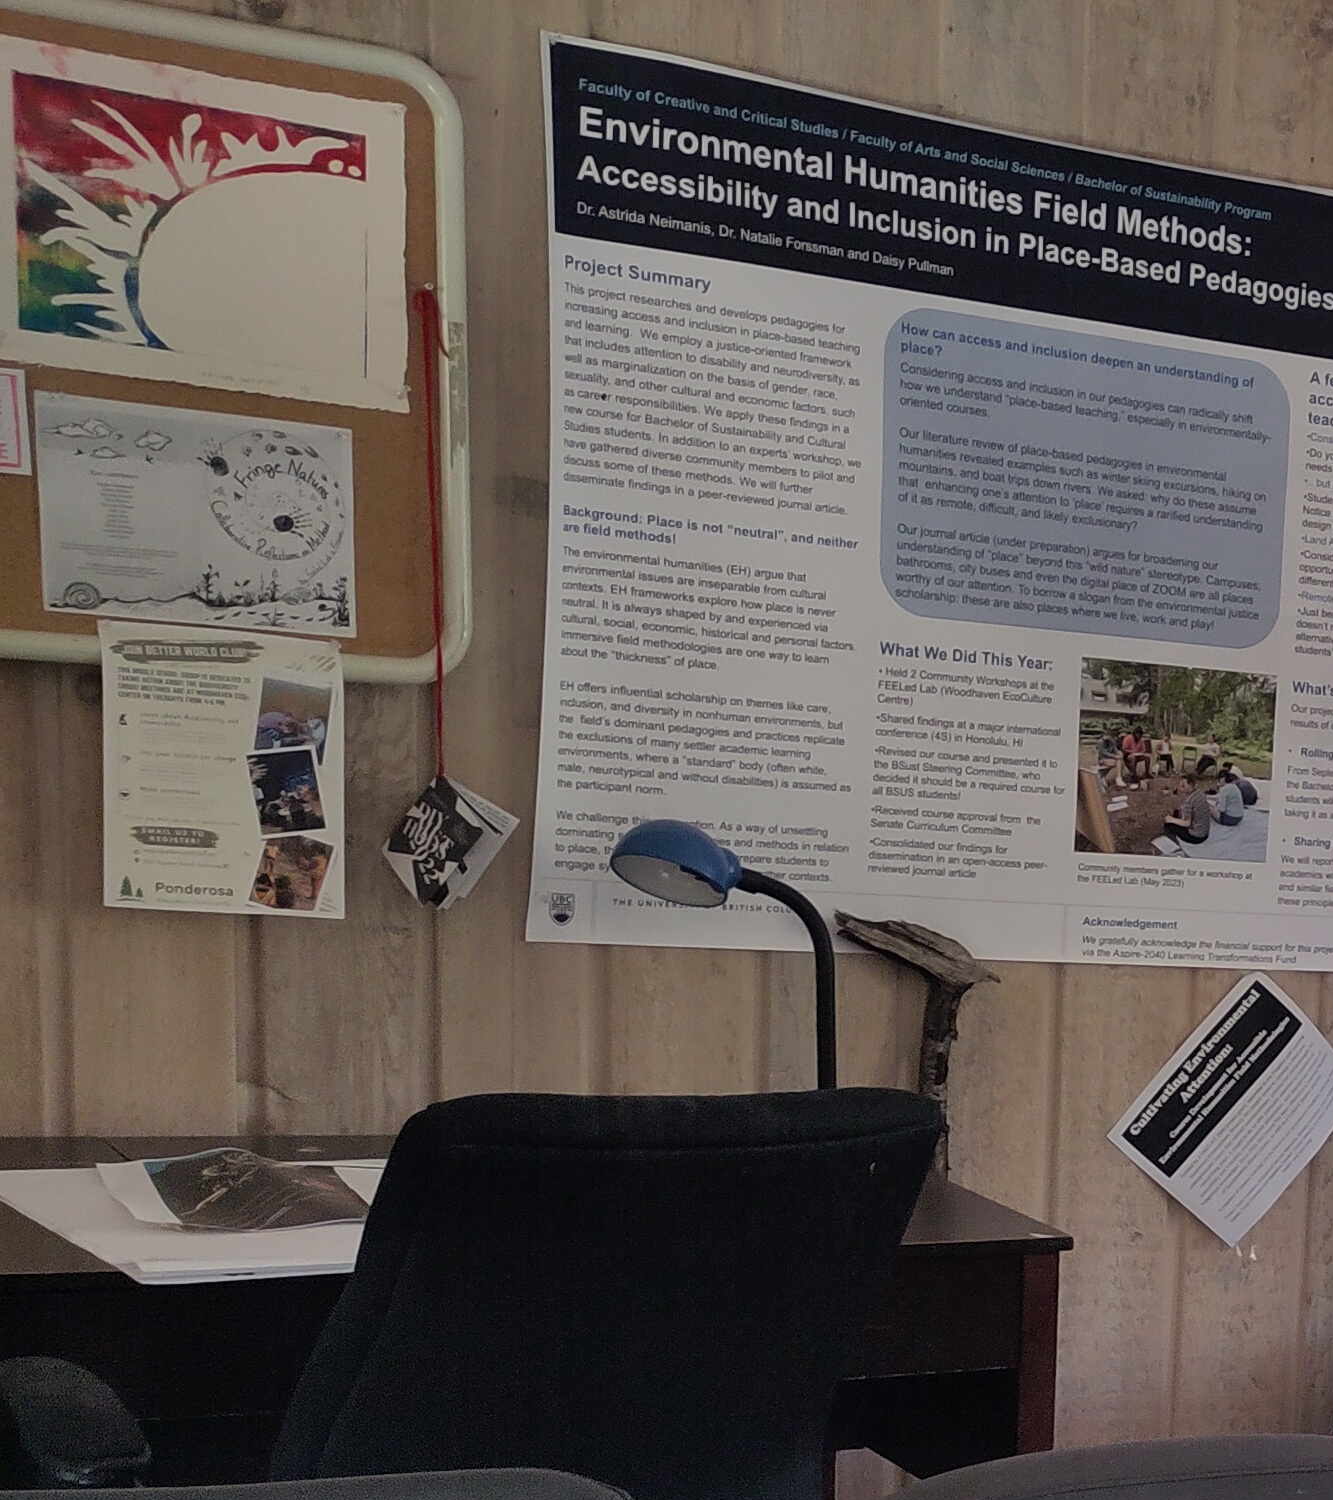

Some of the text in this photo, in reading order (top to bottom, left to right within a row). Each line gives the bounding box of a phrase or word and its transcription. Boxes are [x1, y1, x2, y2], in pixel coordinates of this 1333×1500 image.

[578, 77, 632, 101] Faculty
[635, 89, 651, 102] of
[654, 91, 710, 113] Creative
[713, 105, 737, 119] and
[740, 108, 787, 128] Critical
[790, 118, 839, 139] Studies
[850, 129, 897, 152] Faculty
[899, 140, 914, 152] of
[914, 142, 941, 158] Arts
[943, 150, 968, 163] and
[970, 153, 1008, 171] Social
[1010, 161, 1065, 182] Sciences
[1074, 173, 1128, 193] Bachelor
[1129, 184, 1143, 196] of
[1144, 186, 1222, 214] Sustainability
[1224, 201, 1272, 221] Program
[580, 105, 1251, 256] Environmental Humanities Field Methods:
[576, 155, 778, 218] Accessibility
[787, 197, 839, 224] and
[849, 201, 976, 248] Inclusion
[985, 226, 1009, 254] in
[1018, 232, 1180, 284] Place-Based
[576, 201, 954, 276] Dr. Astrida Neimanis, Dr. Natalie Forssman and Daisy Pullman
[564, 254, 711, 294] Project Summary
[900, 341, 942, 356] place?
[901, 321, 1254, 389] How can access and inclusion deepen an understanding of
[1309, 371, 1320, 385] A
[234, 458, 330, 499] Fringe Natures
[562, 522, 676, 544] are field methods!
[563, 504, 642, 524] Background:
[647, 514, 683, 529] Place
[686, 518, 698, 531] is
[702, 523, 723, 534] not
[790, 533, 813, 544] and
[816, 536, 858, 549] neither
[562, 545, 806, 582] The environmental humanities (EH) argue that
[879, 641, 1052, 671] What We Did This Year:
[877, 679, 1052, 704] FEELed Lab (Woodhaven EcoCulture
[1300, 747, 1333, 761] Rolling
[1293, 836, 1331, 850] Sharing
[155, 882, 234, 897] Ponderosa
[553, 896, 573, 904] UBC
[1082, 916, 1177, 930] Acknowledgement
[1129, 988, 1261, 1136] Cultivating Environmental
